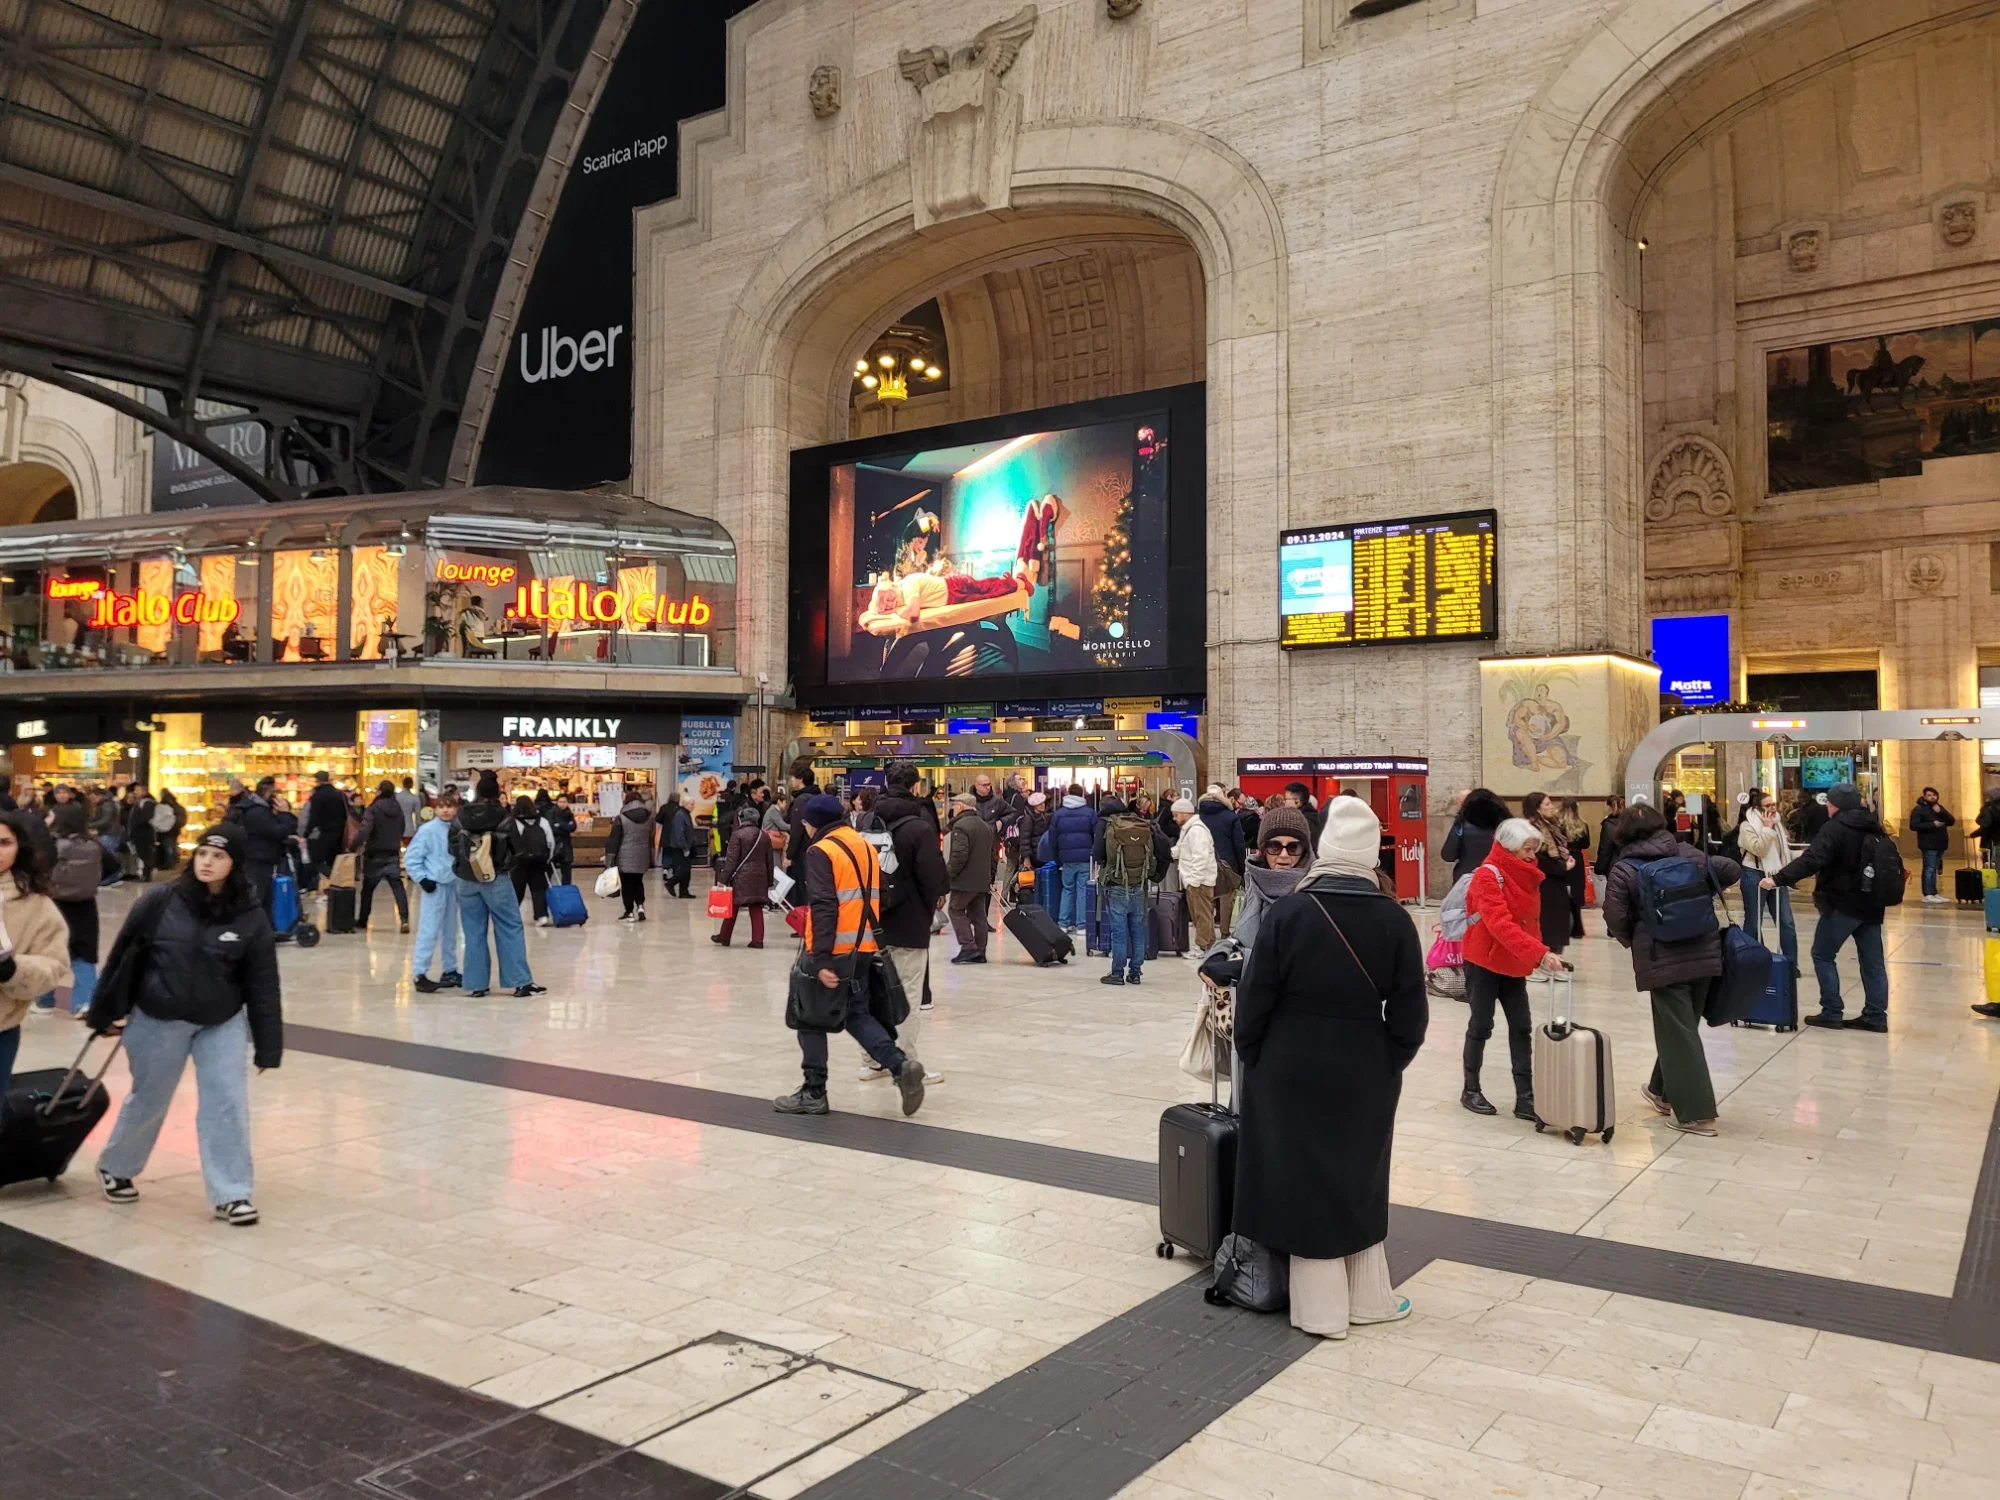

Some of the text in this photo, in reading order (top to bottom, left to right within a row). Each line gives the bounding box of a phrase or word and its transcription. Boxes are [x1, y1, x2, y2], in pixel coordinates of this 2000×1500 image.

[583, 134, 668, 174] Scarica l'app
[520, 324, 623, 383] Uber
[1354, 526, 1383, 535] PARTENZE
[1286, 531, 1344, 544] 09.12.2024
[435, 559, 516, 587] lounge
[49, 579, 101, 600] lounge
[175, 593, 240, 624] Club
[1082, 639, 1151, 651] MONTICELLO
[1670, 680, 1712, 691] Motta
[502, 717, 621, 738] FRANKLY
[682, 720, 731, 729] BUBBLE TEA
[691, 730, 721, 738] COFFEE
[682, 738, 730, 747] BREAKFAST
[691, 747, 721, 755] DONUT
[1806, 745, 1853, 758] Centrale
[1246, 763, 1276, 771] BIGLIETTI
[1280, 763, 1304, 771] TICKET
[1353, 762, 1373, 770] SPEED
[1373, 762, 1394, 770] TRAIN
[1181, 787, 1193, 801] D
